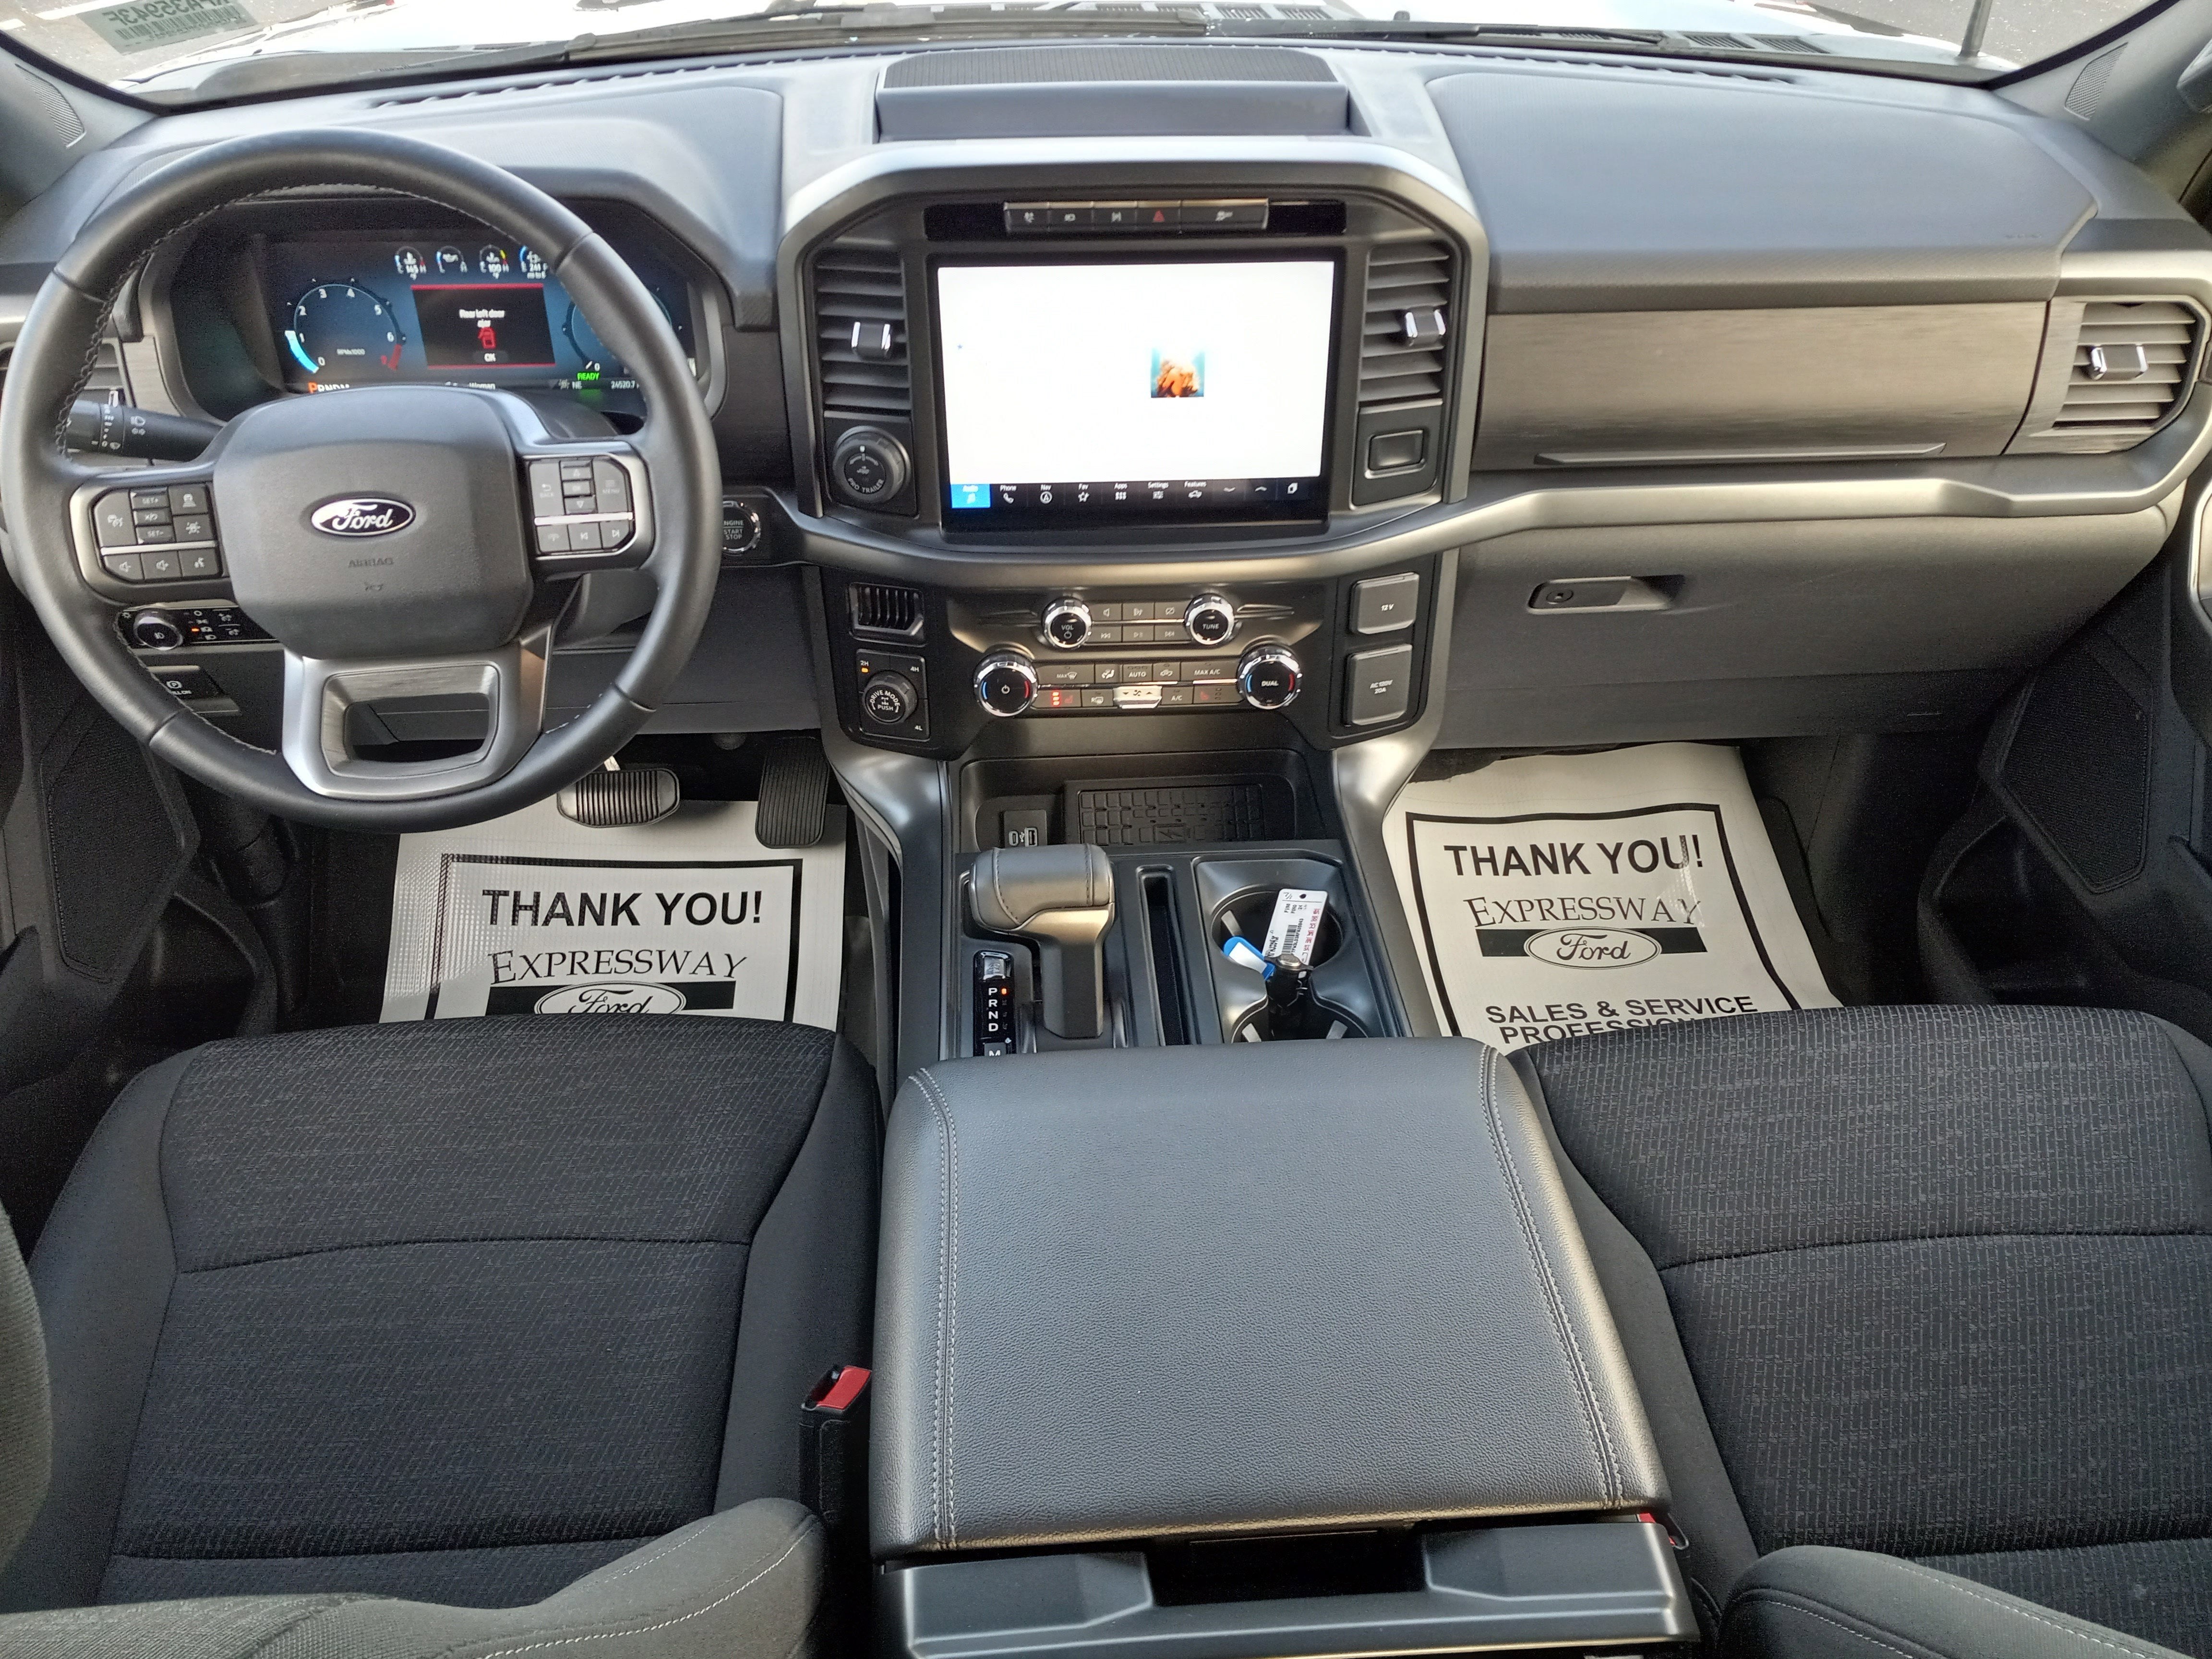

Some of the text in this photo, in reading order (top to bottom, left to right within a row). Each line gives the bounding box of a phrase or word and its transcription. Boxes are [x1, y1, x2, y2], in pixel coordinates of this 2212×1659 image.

[319, 289, 327, 299] 3
[347, 288, 355, 298] 4
[298, 306, 307, 316] 2
[374, 304, 382, 315] 5
[300, 333, 305, 343] 1
[386, 331, 394, 342] 6
[318, 357, 325, 366] 0
[484, 353, 496, 362] OK
[594, 362, 601, 372] 0
[577, 373, 600, 381] READY
[848, 478, 884, 493] PRO TRAILER
[331, 504, 394, 530] Ford
[869, 690, 901, 706] DRIVE MODE
[1444, 834, 1705, 877] THANK YOU!
[481, 890, 762, 926] THANK YOU!
[1556, 933, 1632, 961] Ford
[488, 949, 748, 985] EXPRESSWAY
[988, 987, 998, 996] P
[567, 988, 653, 1014] Ford
[988, 998, 998, 1008] R
[1485, 995, 1758, 1023] SALES & SERVICE
[988, 1010, 998, 1020] N
[988, 1022, 998, 1032] D
